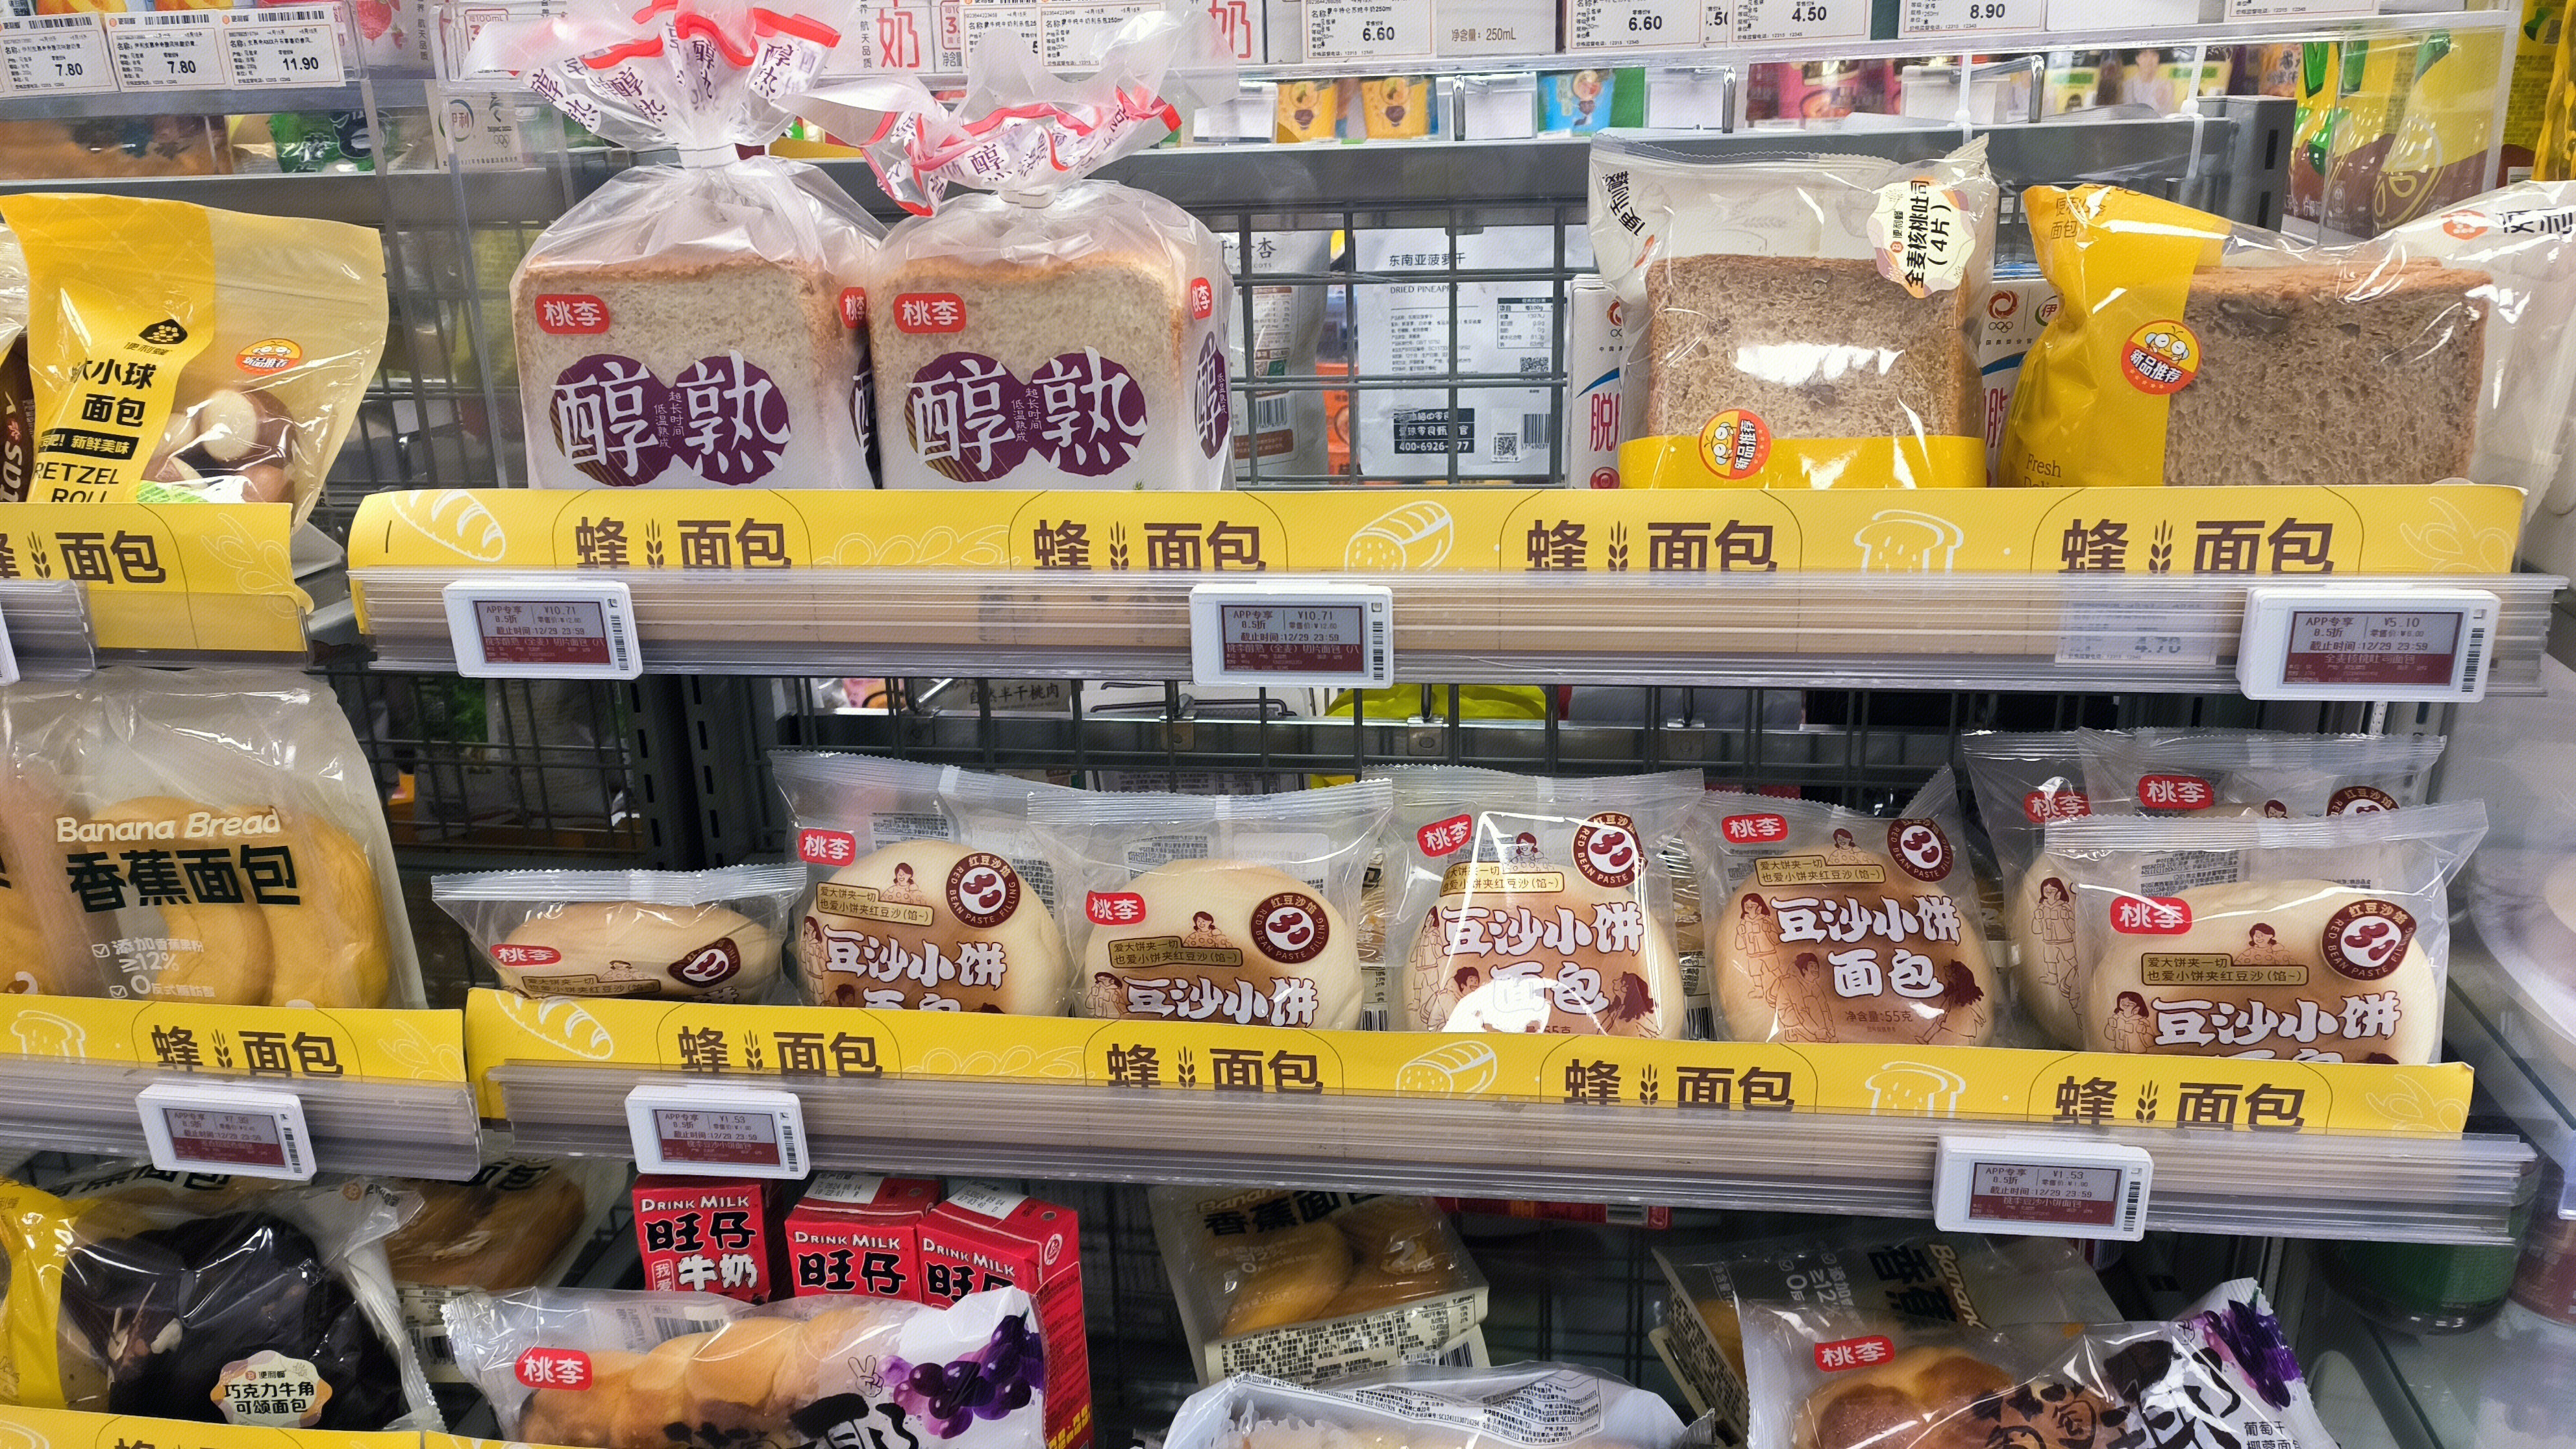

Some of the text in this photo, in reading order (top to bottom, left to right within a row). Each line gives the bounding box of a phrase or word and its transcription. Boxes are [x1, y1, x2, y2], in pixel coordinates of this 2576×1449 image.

[1629, 16, 1662, 31] 6.60
[1792, 6, 1827, 22] 4.50
[1970, 3, 2005, 19] 8.90
[876, 8, 920, 68] 奶
[1363, 27, 1395, 42] 6.60
[55, 63, 83, 76] 7.80
[167, 60, 196, 73] 7.80
[282, 56, 319, 71] 11.90
[1905, 179, 1930, 288] 全麦核桃吐司
[2050, 221, 2078, 240] 面包
[1417, 285, 1461, 293] PINEAPPE
[543, 300, 602, 327] 桃李
[902, 300, 959, 327] 桃李
[2128, 348, 2181, 384] 新品推荐
[82, 393, 146, 427] 面包
[551, 350, 791, 477] 醇熟
[669, 391, 685, 438] 超长时间
[907, 346, 1148, 472] 醇熟
[1011, 399, 1029, 443] 低温熟成
[1025, 388, 1043, 430] 超长时间
[654, 404, 671, 450] 低温熟成
[71, 435, 130, 454] 新鲜美味
[1399, 441, 1469, 452] 400-6926-77
[1734, 419, 1756, 471] 新品推荐
[2025, 453, 2062, 478] Fresh
[576, 516, 791, 569] 蜂 面包
[1033, 520, 1266, 571] 蜂 面包
[1526, 519, 1777, 572] 蜂 面包
[2059, 518, 2334, 574] 蜂 面包
[55, 530, 166, 584] 面包
[487, 606, 576, 615] APP专享 ¥10.71
[1233, 610, 1333, 621] APP专享 ¥10.71
[2306, 617, 2420, 628] APP专享 ¥5.10
[2031, 795, 2087, 818] 桃李
[2146, 781, 2206, 804] 桃李
[56, 809, 281, 843] Banana Bread
[1424, 820, 1470, 851] 桃李
[1729, 818, 1782, 839] 桃李
[803, 835, 850, 860] 桃李
[1577, 828, 1629, 884] RED BEAN PASTE
[1760, 859, 1824, 871] 爱大饼夹一切
[1892, 846, 1912, 874] BEAN
[1914, 869, 1939, 878] PASTE
[66, 844, 301, 913] 香蕉面包
[820, 886, 876, 903] 爱大饼夹一切
[949, 889, 964, 914] BEAN
[965, 912, 995, 924] PASTE
[1093, 898, 1139, 921] 桃李
[1770, 895, 1961, 947] 豆沙小饼
[2120, 902, 2184, 929] 桃李
[1443, 902, 1643, 958] 豆沙小饼
[111, 937, 204, 956] 添加香蕉果粉
[498, 947, 553, 963] 桃李
[823, 924, 1007, 990] 豆沙小饼
[1113, 941, 1178, 953] 爱大饼夹一切
[1256, 932, 1274, 953] BEAN
[1276, 951, 1307, 960] PASTE
[1827, 948, 1944, 998] 面包
[2148, 957, 2228, 969] 爱大饼夹一切
[2328, 945, 2349, 970] BEAN
[2351, 965, 2389, 977] PASTE
[1489, 961, 1611, 1014] 面包
[1122, 976, 1319, 1028] 豆沙小饼
[1844, 1010, 1913, 1022] 净含量:55克
[2151, 990, 2402, 1047] 豆沙小饼
[150, 1025, 343, 1078] 蜂 面包
[677, 1026, 884, 1079] 蜂 面包
[1106, 1043, 1324, 1095] 蜂 面包
[1564, 1058, 1796, 1111] 蜂 面包
[665, 1113, 699, 1122] APP专享
[2053, 1076, 2306, 1133] 蜂 面包
[1985, 1167, 2027, 1177] APP专享
[641, 1195, 750, 1213] DRINK MILK
[645, 1211, 757, 1253] 旺仔
[795, 1232, 900, 1250] DRINK MILK
[798, 1248, 908, 1294] 旺仔
[923, 1237, 1016, 1277] DRINK MILK
[678, 1254, 758, 1292] 牛奶
[1821, 1341, 1887, 1367] 桃李
[258, 1370, 286, 1380] 便利蜂
[523, 1356, 584, 1385] 桃李
[224, 1383, 316, 1400] 巧克力牛角
[236, 1398, 308, 1415] 可颂面包
[2244, 1420, 2285, 1436] 葡萄干
